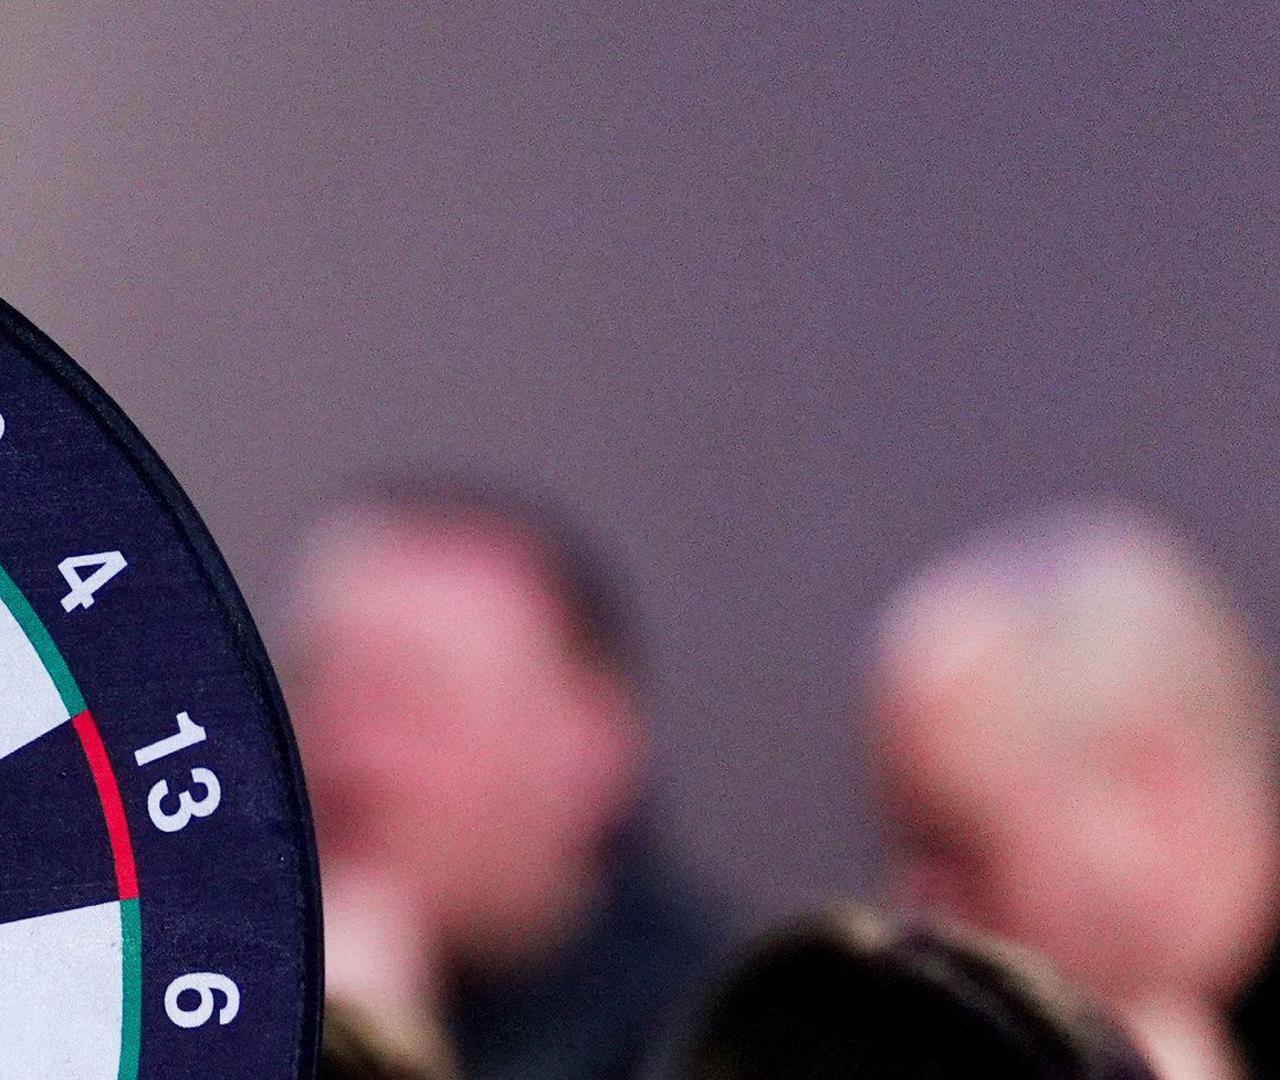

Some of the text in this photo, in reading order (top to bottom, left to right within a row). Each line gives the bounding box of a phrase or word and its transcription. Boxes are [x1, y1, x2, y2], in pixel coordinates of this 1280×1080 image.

[57, 550, 128, 613] 4
[134, 711, 221, 833] 13
[164, 971, 241, 1029] 6
